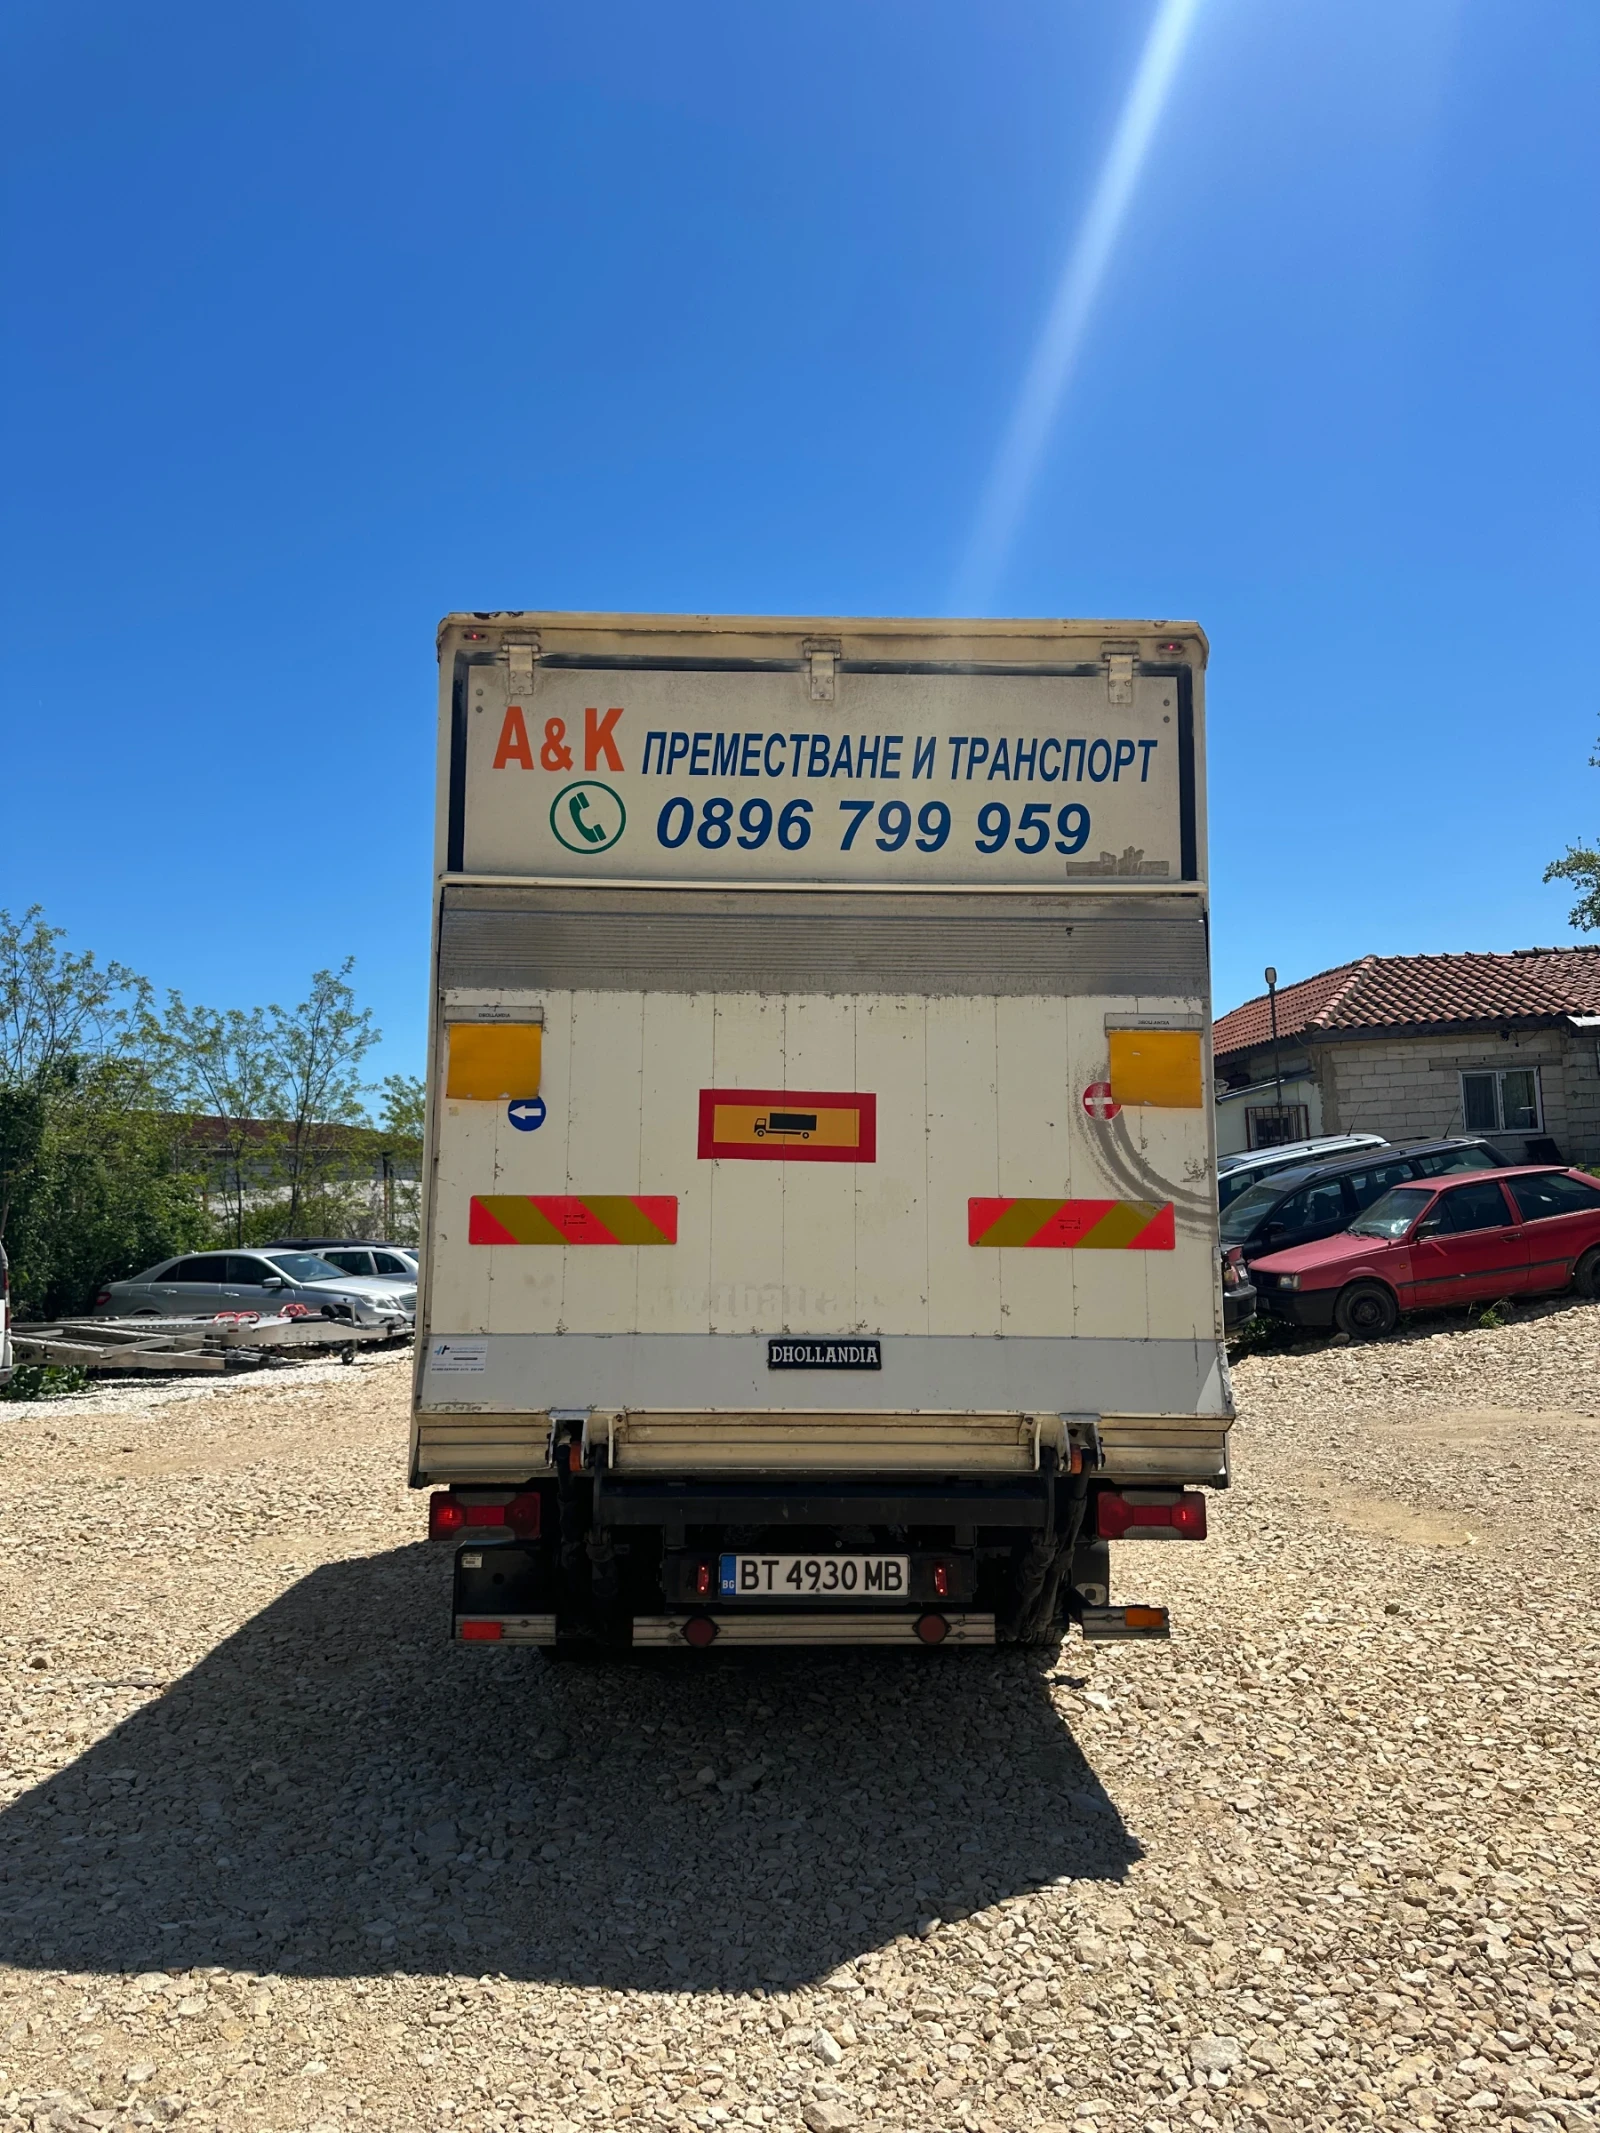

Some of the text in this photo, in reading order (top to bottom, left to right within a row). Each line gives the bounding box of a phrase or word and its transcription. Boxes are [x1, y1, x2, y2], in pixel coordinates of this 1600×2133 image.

[494, 707, 624, 771] A&K
[643, 732, 1158, 782] ПРЕМЕСТВАНЕ И ТРАНСПОРТ
[658, 798, 1090, 854] 0896 799 959
[771, 1346, 878, 1362] DHOLLANDIA
[722, 1580, 735, 1589] BG
[741, 1560, 903, 1590] BT 4930 MB
